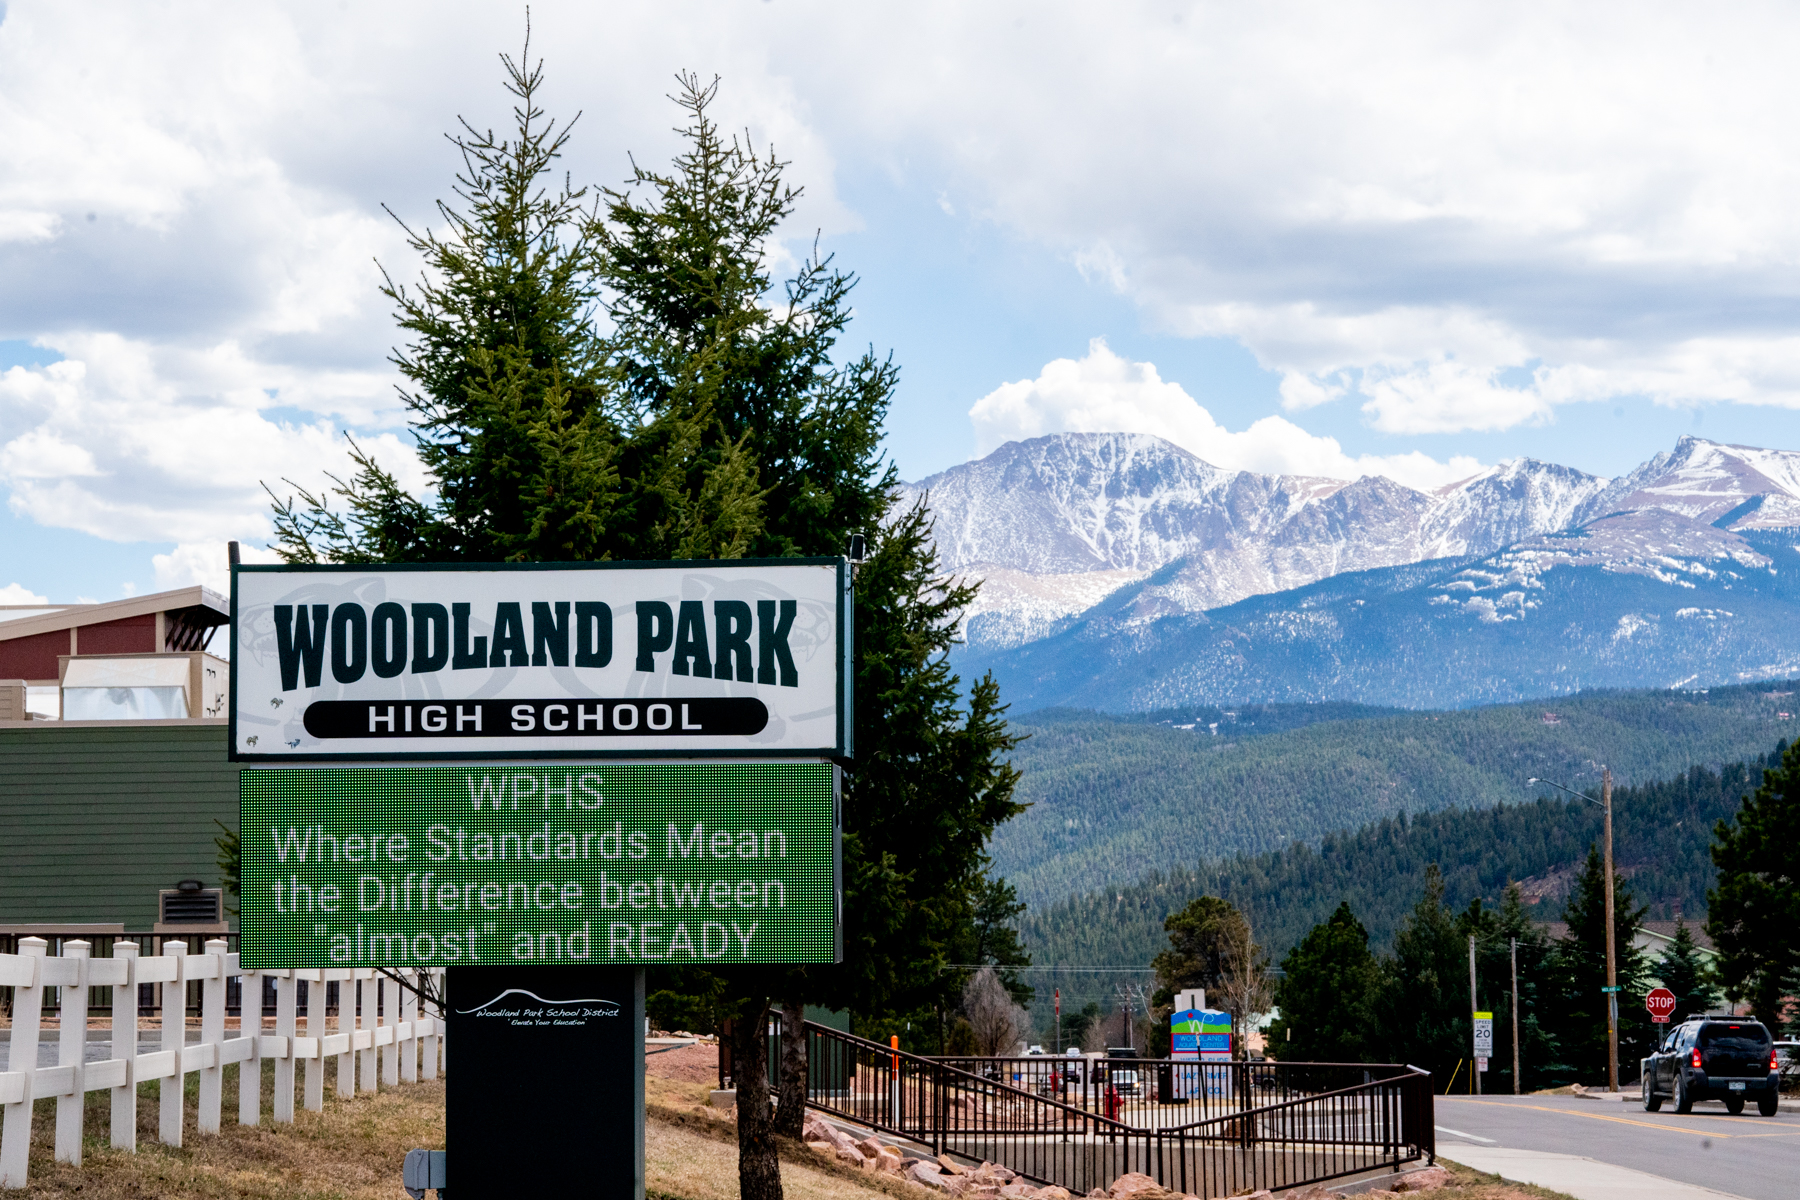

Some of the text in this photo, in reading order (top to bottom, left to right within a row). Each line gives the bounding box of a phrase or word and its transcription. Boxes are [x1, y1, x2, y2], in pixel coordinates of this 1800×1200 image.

[273, 600, 799, 692] WOODLAND PARK
[368, 702, 703, 733] HIGH SCHOOL
[466, 773, 604, 811] WPHS
[272, 822, 788, 863] Where Standards Mean
[272, 871, 787, 914] the Difference between
[314, 921, 760, 962] "almost" and READY
[476, 1008, 620, 1018] Woodland Park School District
[1649, 997, 1673, 1008] STOP
[1475, 1029, 1491, 1038] 20
